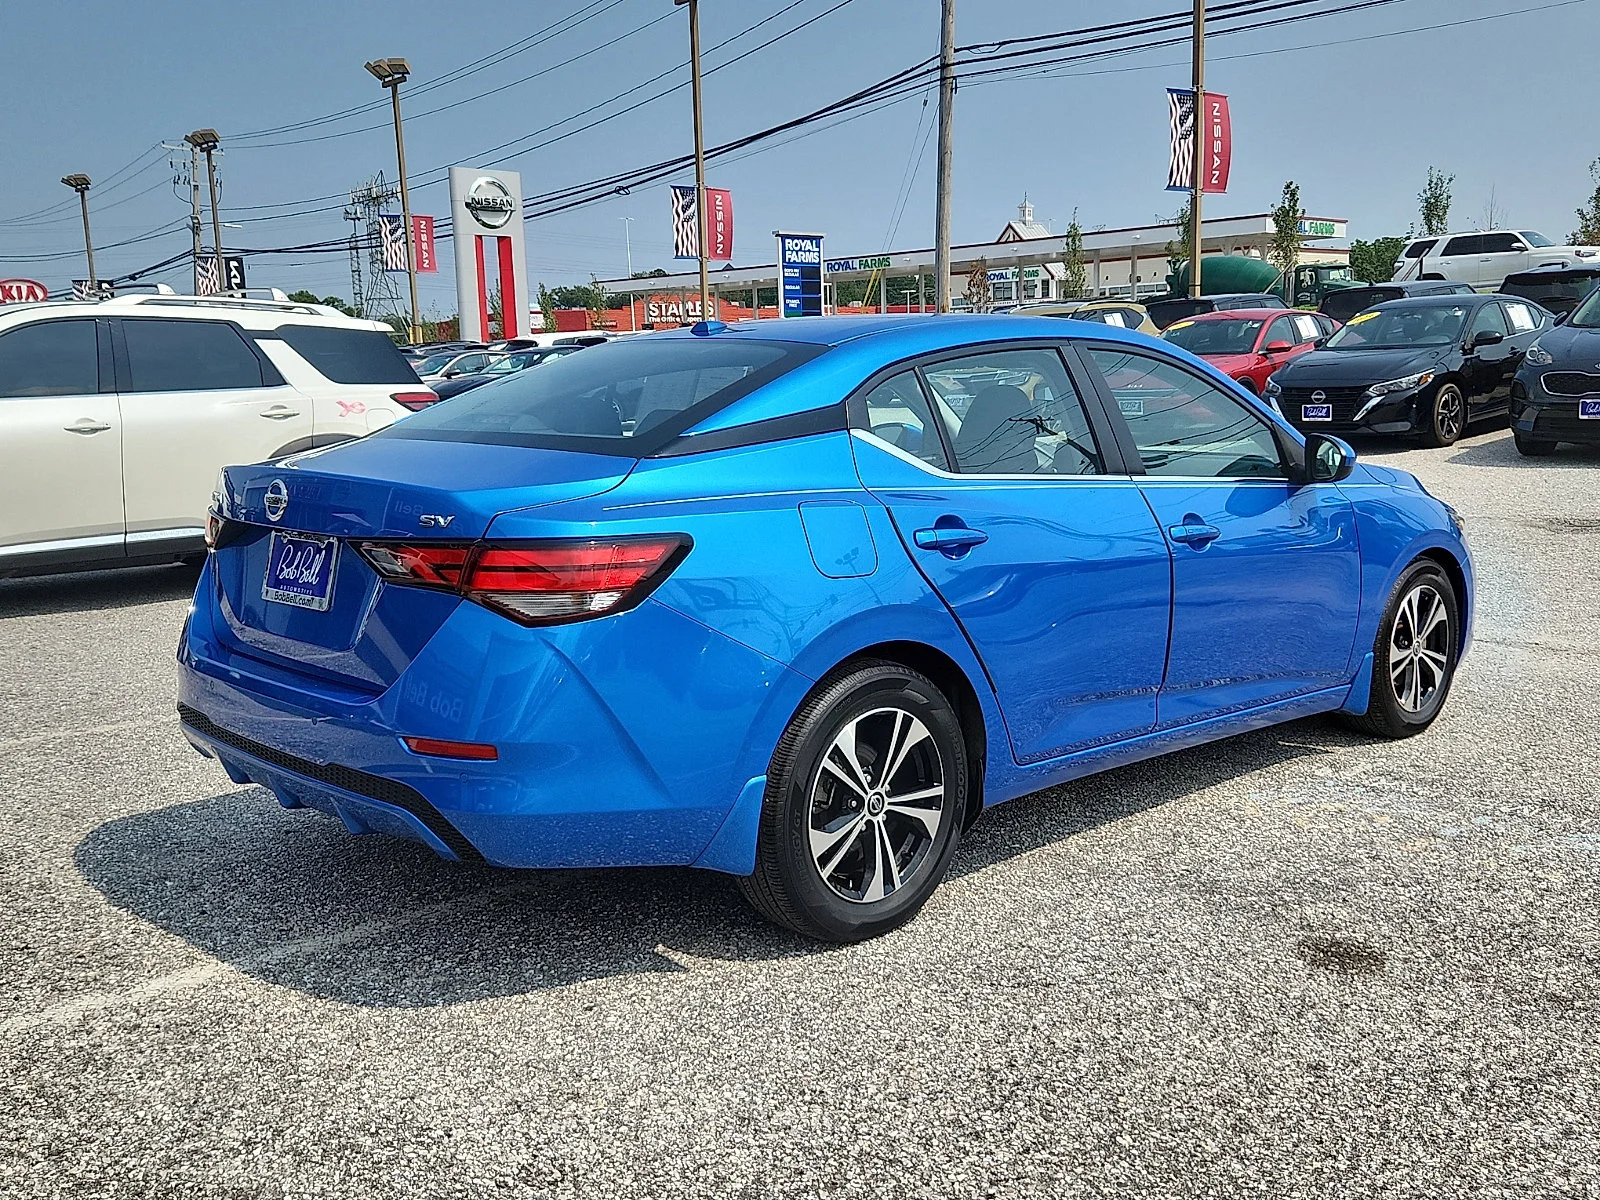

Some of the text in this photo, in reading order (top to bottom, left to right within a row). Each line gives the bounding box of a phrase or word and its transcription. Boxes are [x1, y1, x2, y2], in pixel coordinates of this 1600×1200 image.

[1211, 102, 1222, 184] NISSAN
[470, 197, 513, 208] NISSAN
[714, 194, 725, 255] NISSAN
[1309, 221, 1335, 236] FARMS
[419, 220, 430, 269] NISSAN
[784, 238, 819, 251] ROYAL
[785, 251, 820, 263] FARMS
[826, 256, 891, 273] ROYAL FARMS
[986, 271, 1010, 281] ROYAL
[1, 286, 36, 301] KIA
[419, 515, 455, 527] SV
[276, 545, 326, 584] Bob Bell
